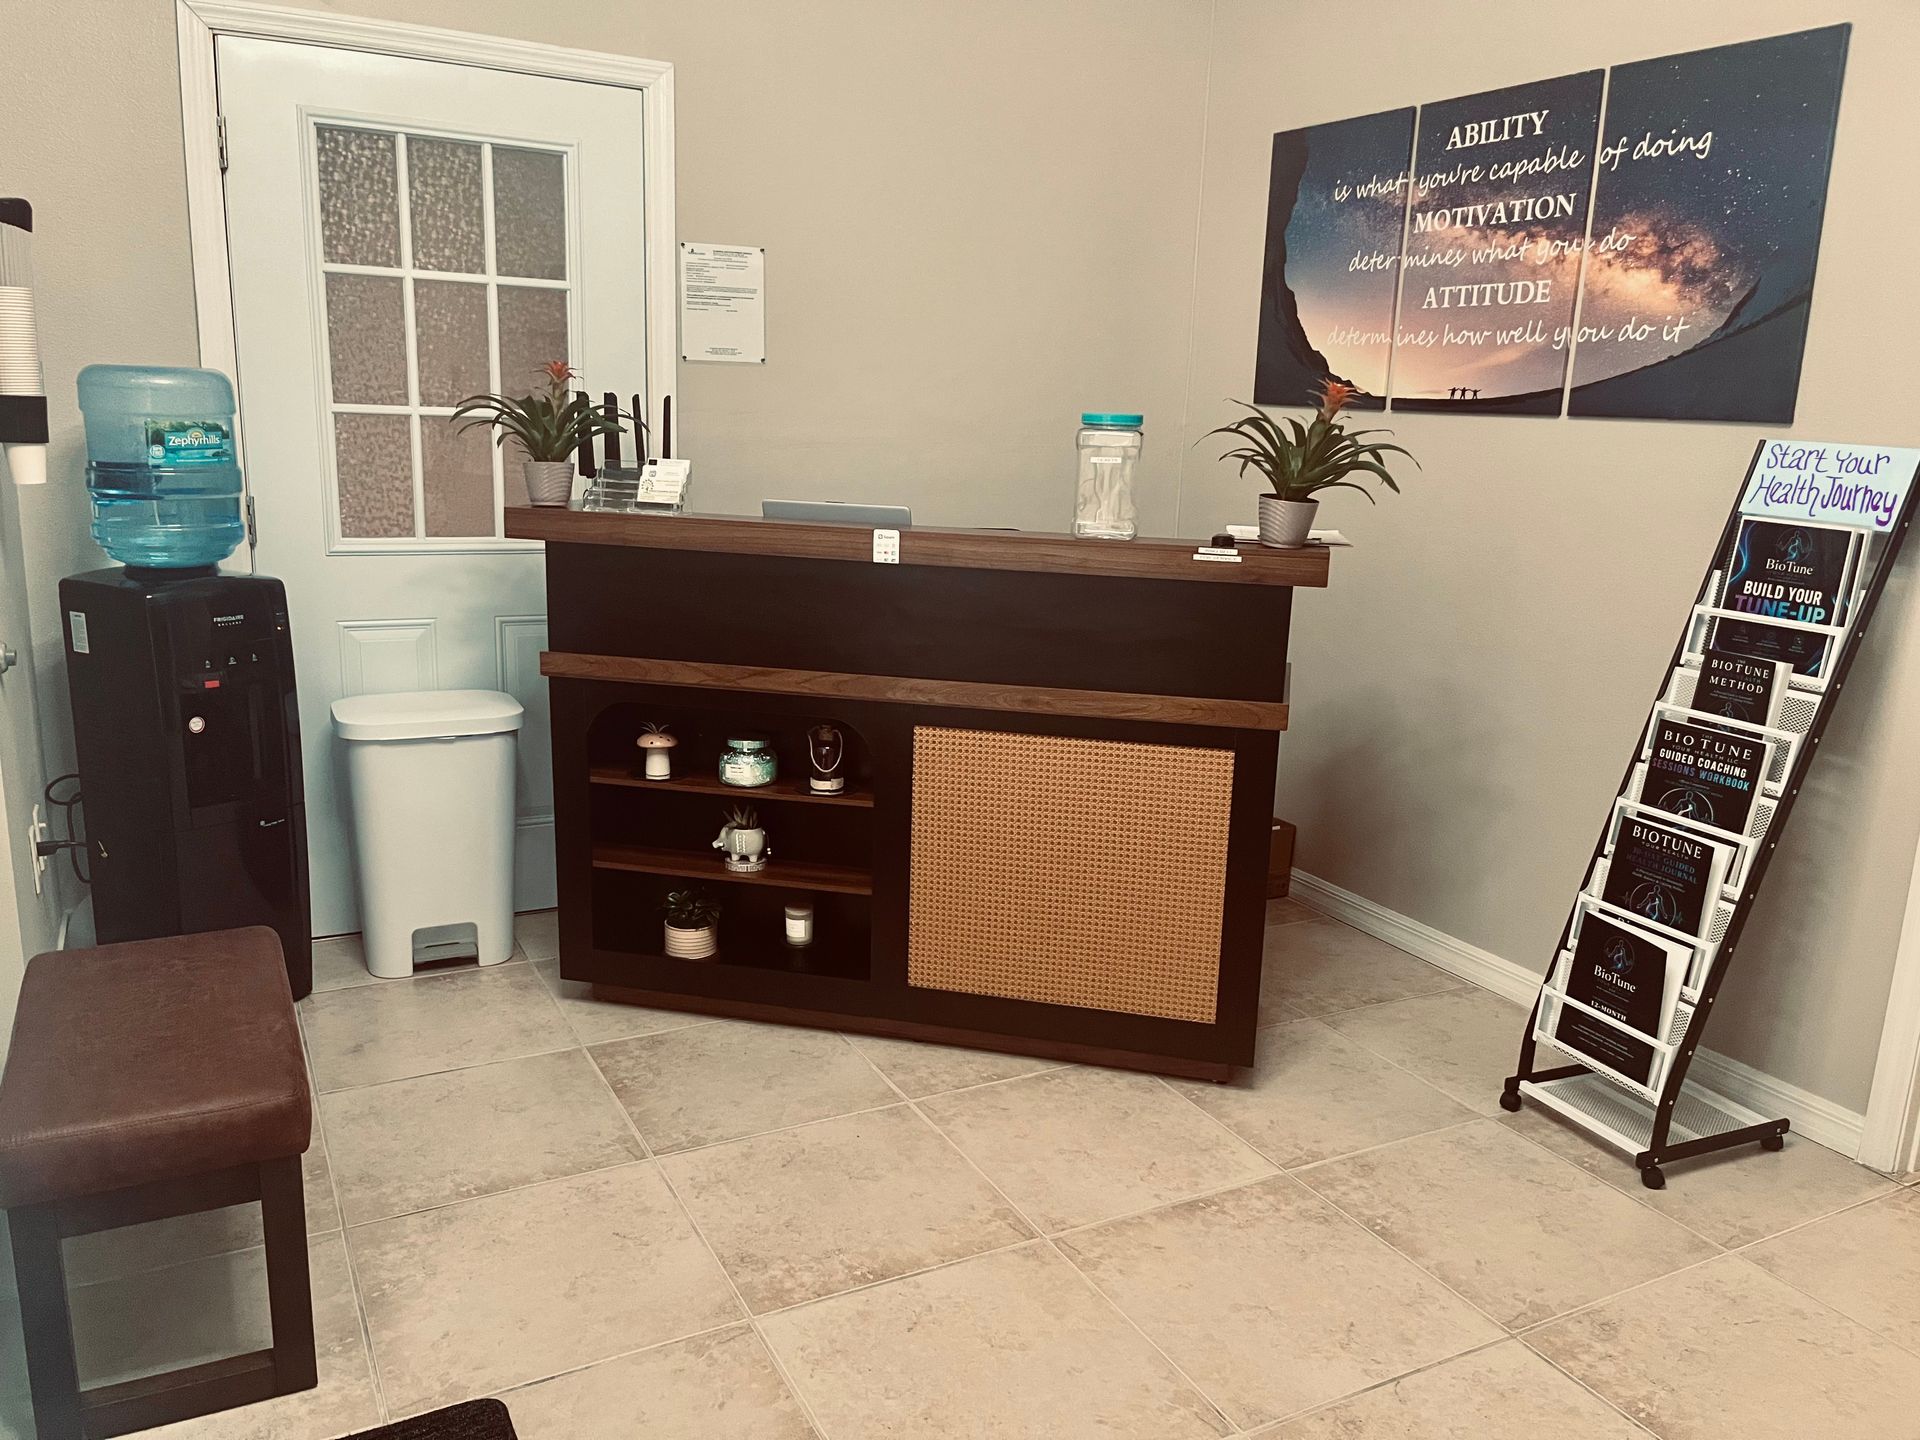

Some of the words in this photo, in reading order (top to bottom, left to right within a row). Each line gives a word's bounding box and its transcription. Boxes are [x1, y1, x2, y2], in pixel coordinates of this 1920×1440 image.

[1446, 109, 1549, 151] ABILITY
[1334, 180, 1353, 203] is
[1356, 171, 1414, 199] what
[1418, 163, 1485, 197] you're
[1489, 145, 1585, 184] capable
[1601, 136, 1629, 171] of
[1632, 129, 1713, 160] doing
[1412, 192, 1577, 234] MOTIVATION
[1349, 246, 1466, 273] determines
[1472, 237, 1532, 264] what
[1535, 237, 1585, 265] you
[1600, 226, 1636, 252] do
[1421, 280, 1552, 310] ATTITUDE
[1327, 324, 1439, 348] determines
[1442, 323, 1492, 347] how
[1496, 320, 1547, 346] well
[1552, 326, 1614, 350] you
[1618, 316, 1656, 342] do
[1662, 316, 1690, 343] it
[167, 434, 221, 448] Zephyrhills
[1766, 443, 1828, 473] Start
[1835, 451, 1891, 475] Your
[1748, 473, 1822, 517] Health
[1820, 475, 1898, 527] Journey
[1765, 557, 1814, 576] BioTune
[1743, 580, 1785, 600] BUILD
[1788, 585, 1823, 607] YOUR
[1734, 594, 1827, 624] TUNE-UP
[1711, 658, 1770, 680] BIOTUNE
[1708, 675, 1764, 694] METHOD
[1659, 748, 1695, 766] GUIDED
[1697, 757, 1748, 779] COACHING
[1671, 744, 1691, 753] YOUR
[1694, 749, 1725, 761] HEALTH
[1652, 757, 1696, 777] SESSIONS
[1698, 769, 1751, 792] WORKBOOK
[1632, 825, 1703, 859] BIOTUNE
[1641, 841, 1660, 850] YOUR
[1662, 848, 1690, 860] HEALTH
[1662, 864, 1698, 885] JOURNAL
[1663, 857, 1696, 874] GUIDED
[1593, 964, 1637, 993] BioTune
[1590, 999, 1628, 1022] 12-MONTH
